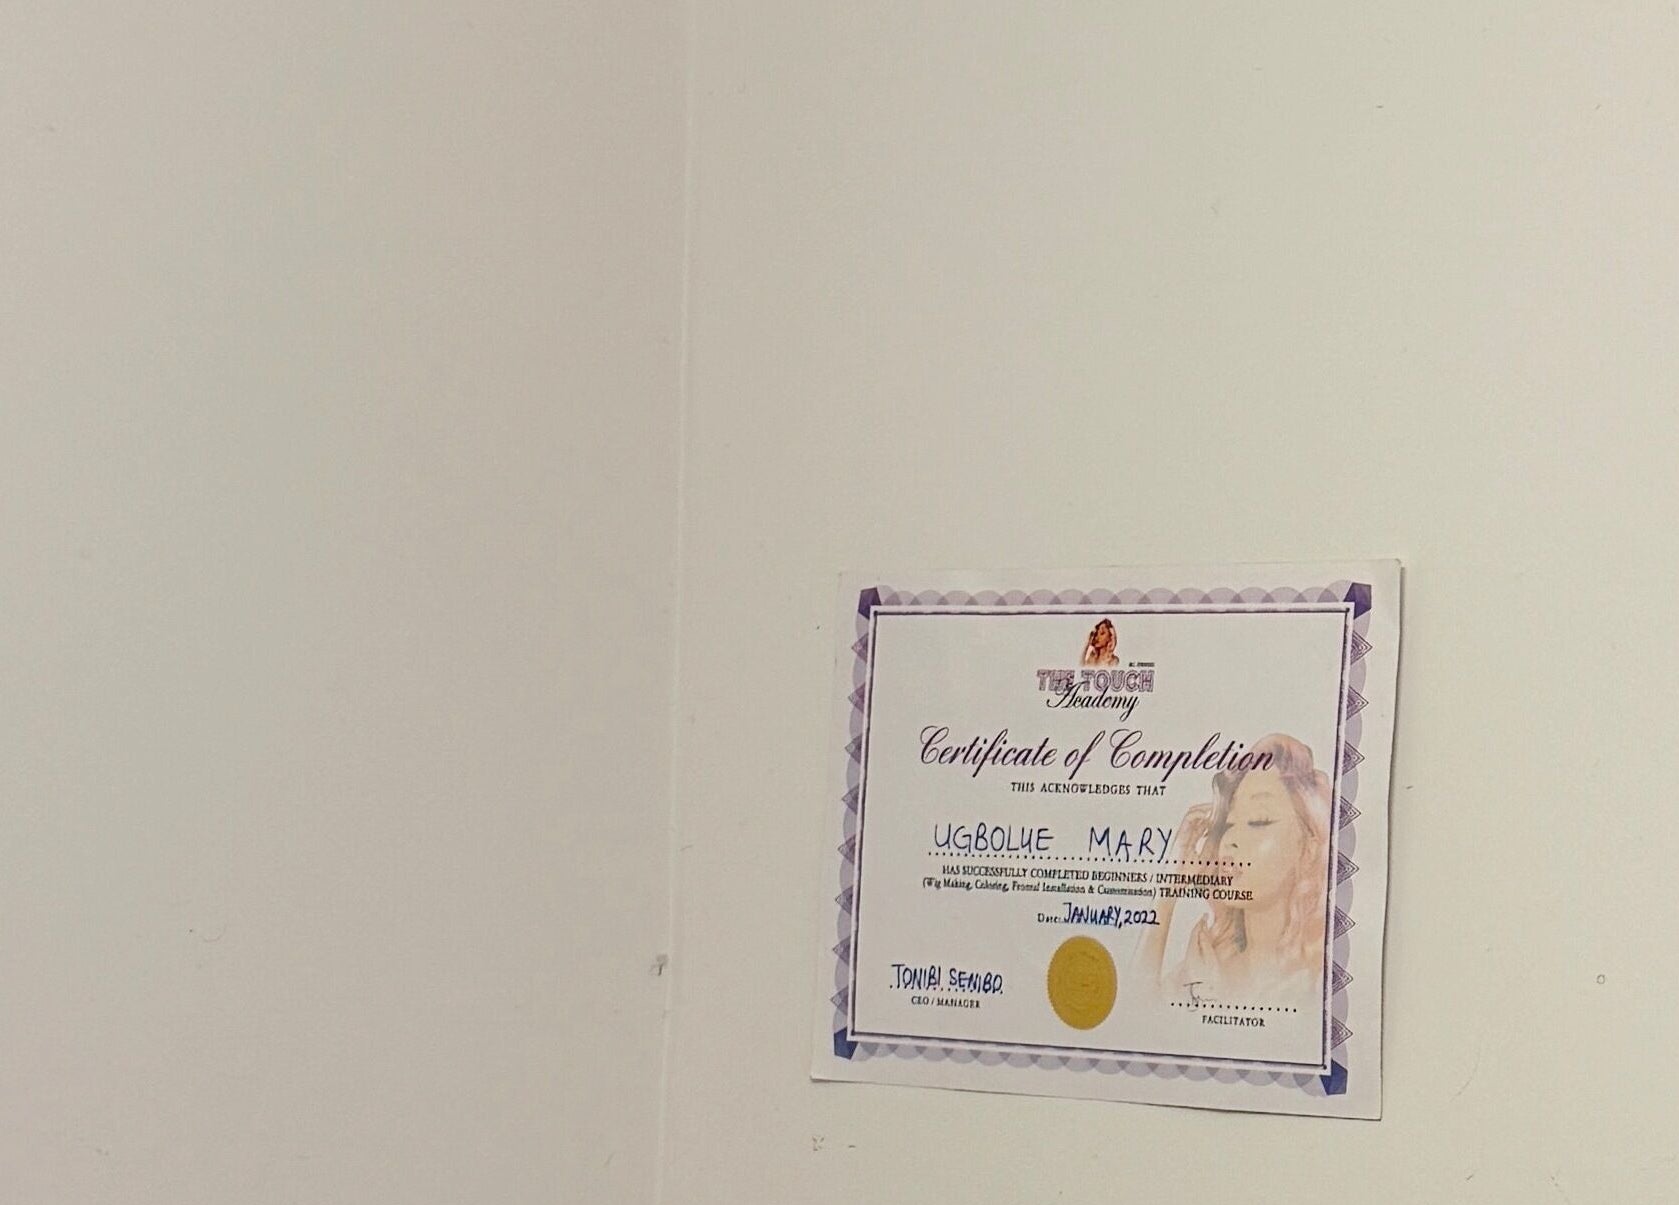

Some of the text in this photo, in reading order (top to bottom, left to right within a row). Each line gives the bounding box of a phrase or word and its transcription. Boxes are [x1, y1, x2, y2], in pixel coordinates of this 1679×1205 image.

[1081, 669, 1155, 693] TOUCH
[1046, 680, 1139, 722] Academy
[919, 725, 1274, 783] Certificate of Completion
[1011, 782, 1166, 796] THIS ACKNOWLEDGES THAT
[934, 822, 1173, 863] UGBOLUE MARY
[942, 865, 960, 875] HAS
[962, 865, 1028, 878] SUCCESSFULLY
[1030, 867, 1089, 881] COMPLETED
[1091, 870, 1148, 884] BEGINNERS
[1156, 872, 1234, 886] INTERMEDIARY
[1160, 887, 1210, 900] TRAINING
[1202, 1015, 1265, 1027] FACILITATOR
